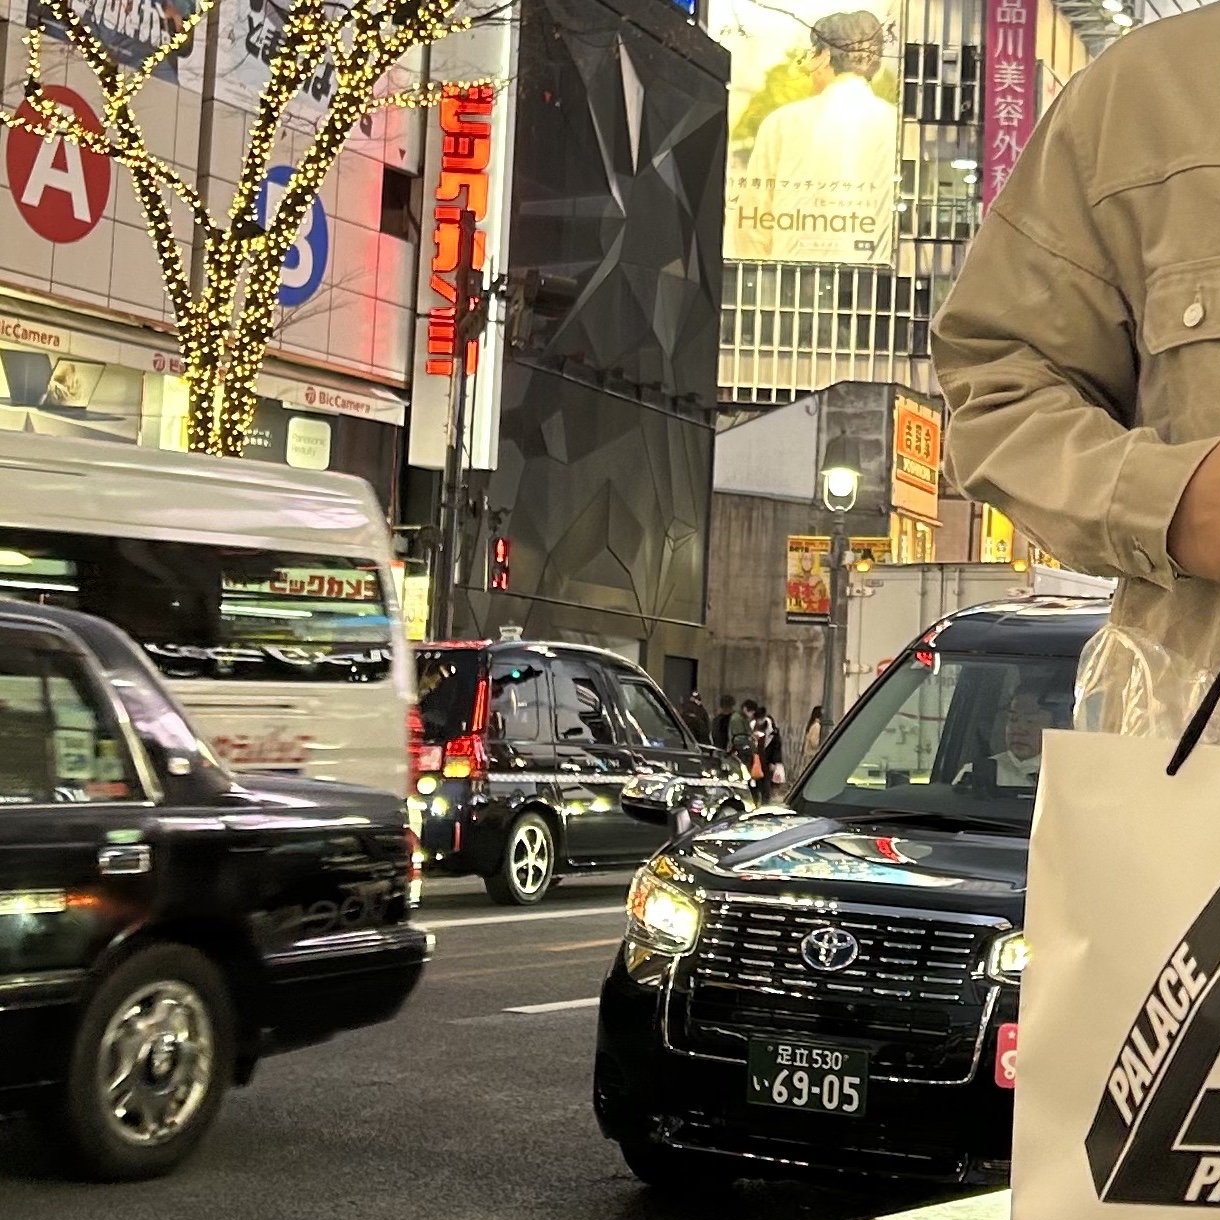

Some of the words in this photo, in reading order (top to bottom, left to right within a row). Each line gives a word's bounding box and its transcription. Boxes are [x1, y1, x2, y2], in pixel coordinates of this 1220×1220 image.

[20, 102, 92, 224] A
[738, 206, 876, 233] Healmate
[0, 319, 60, 347] icCamera
[319, 390, 371, 414] BicCamera
[1108, 942, 1207, 1124] PALACE
[776, 1045, 809, 1067] 足立
[812, 1049, 842, 1070] 530
[753, 1075, 769, 1091] い
[772, 1069, 860, 1112] 69-05
